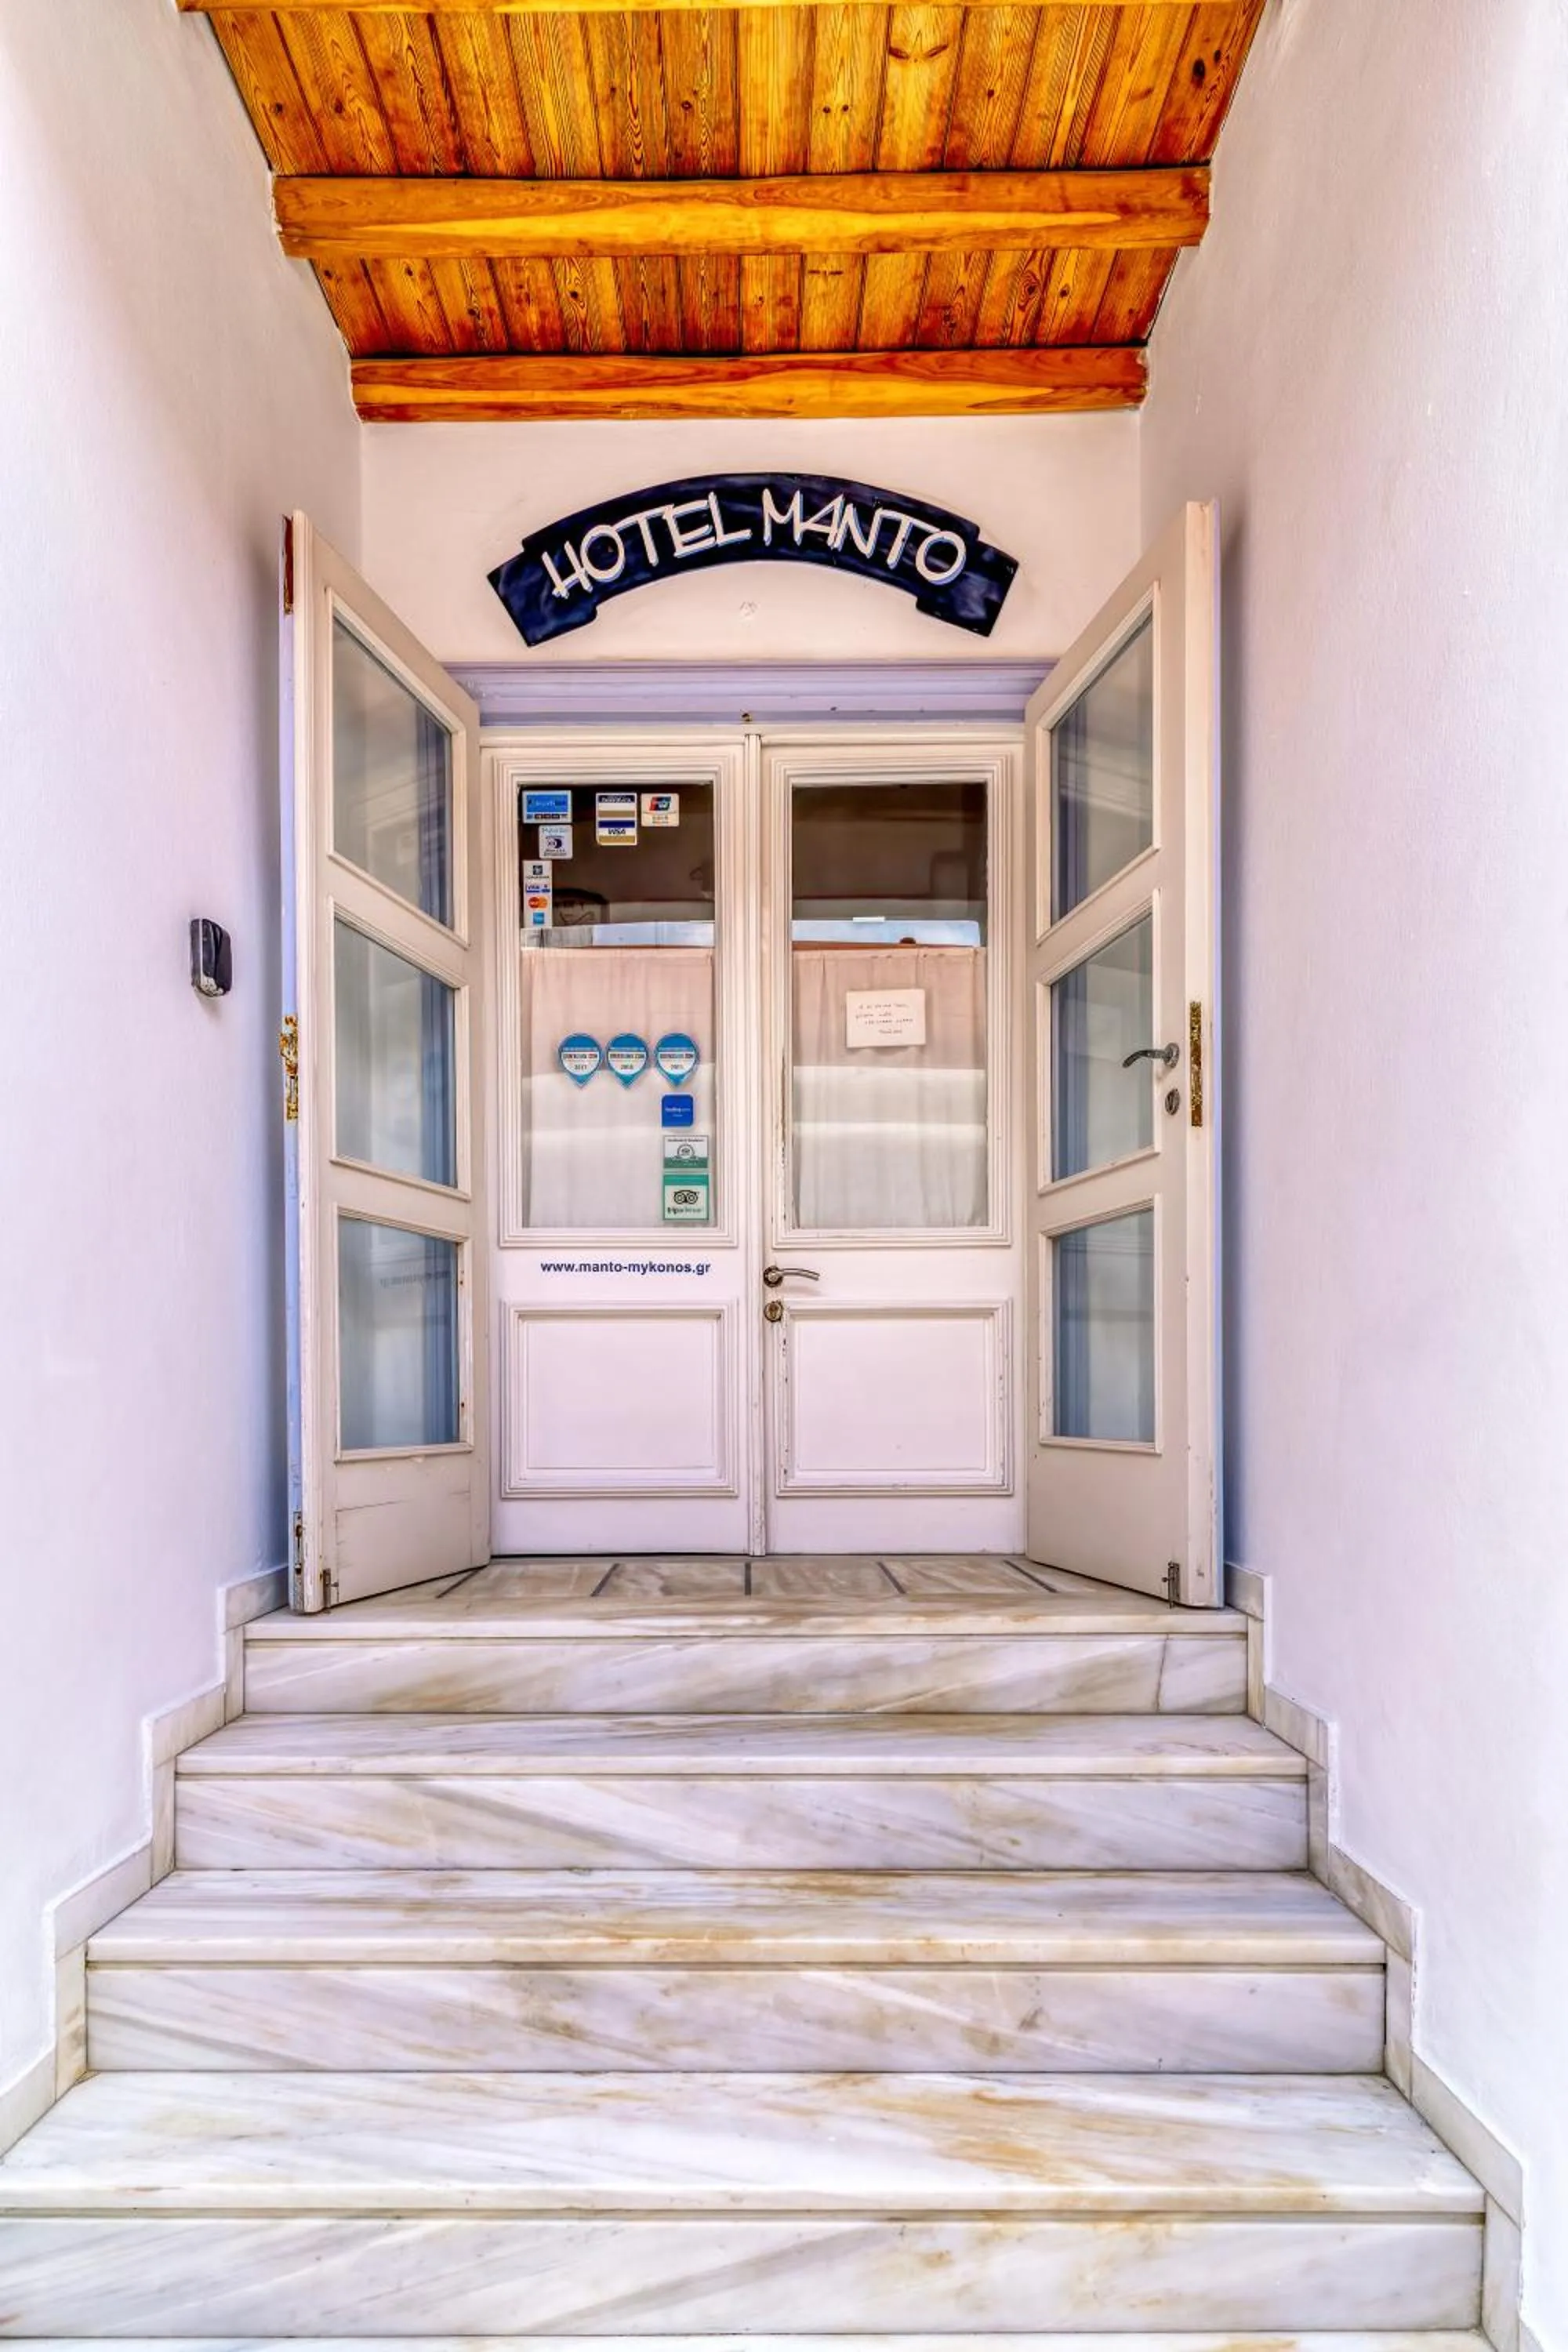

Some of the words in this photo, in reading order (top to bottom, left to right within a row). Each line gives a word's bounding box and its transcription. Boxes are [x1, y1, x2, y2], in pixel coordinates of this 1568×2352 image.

[541, 491, 752, 599] HOTEL
[762, 488, 967, 584] MANTO
[540, 1261, 711, 1276] www.manto-mykonos.gr
